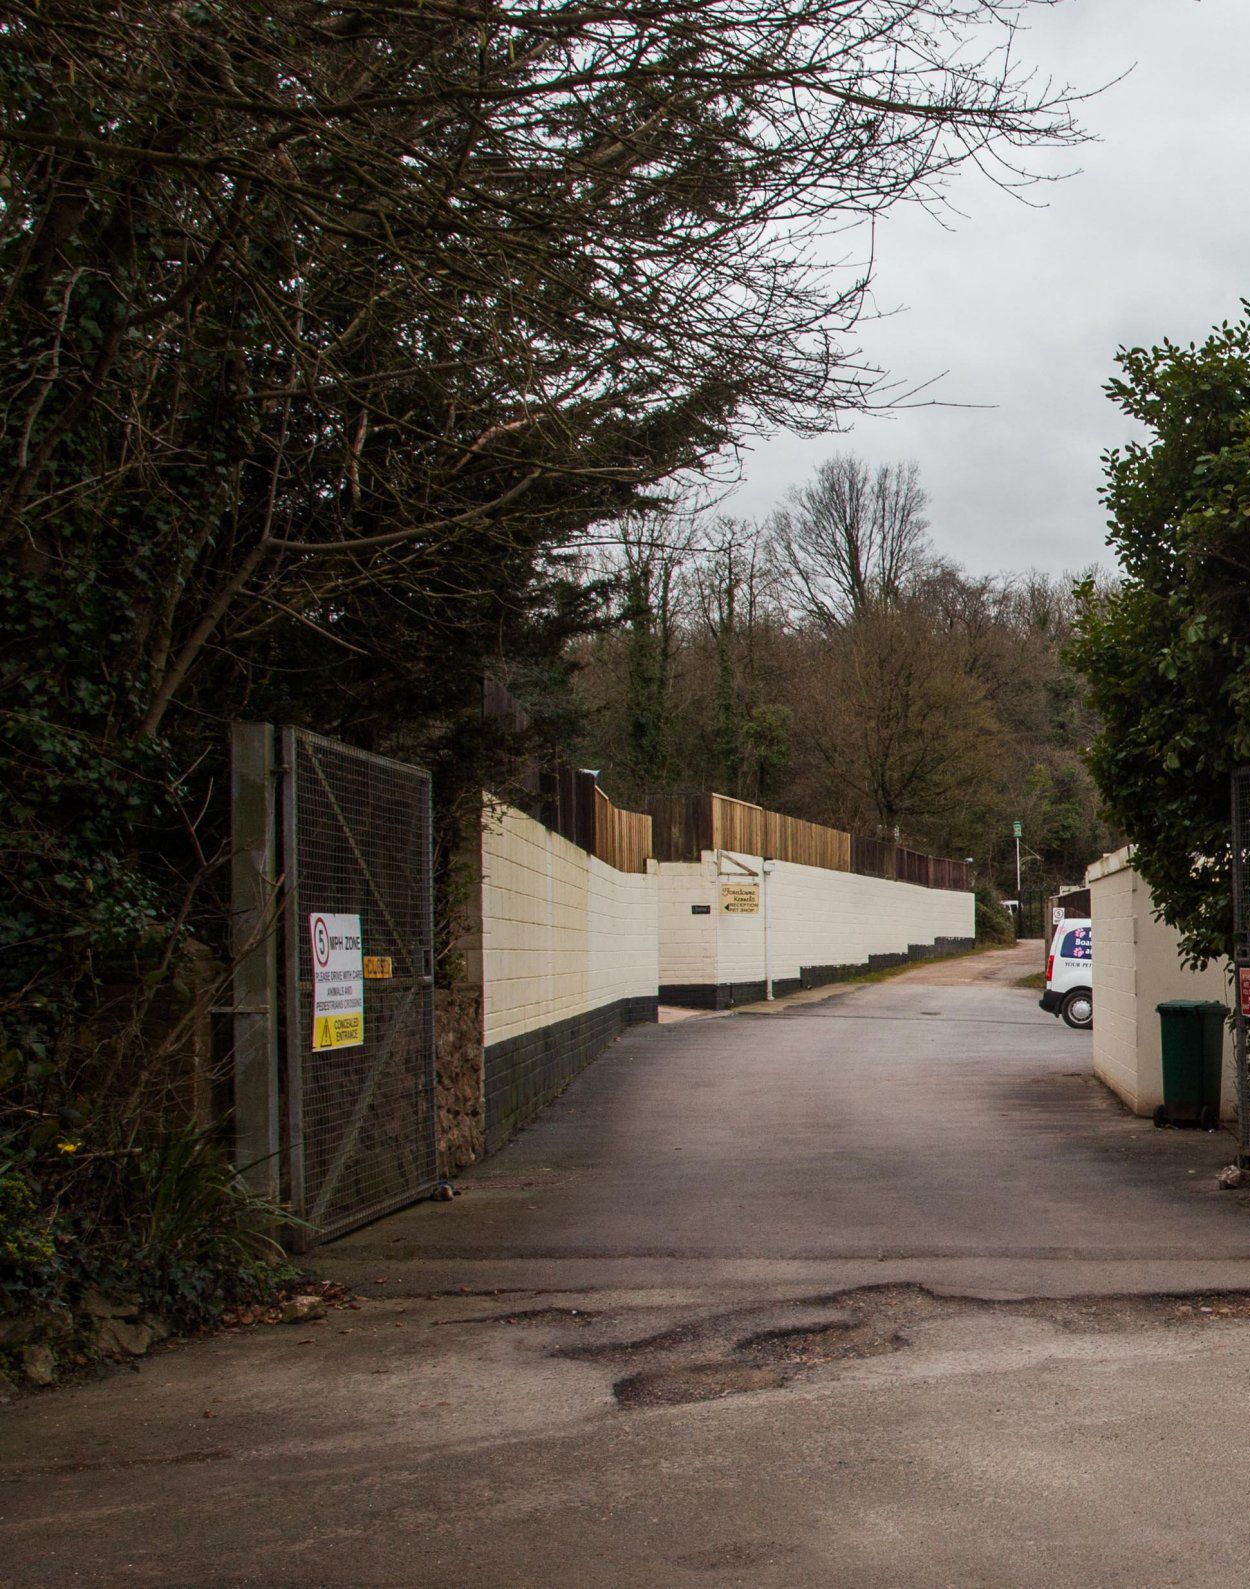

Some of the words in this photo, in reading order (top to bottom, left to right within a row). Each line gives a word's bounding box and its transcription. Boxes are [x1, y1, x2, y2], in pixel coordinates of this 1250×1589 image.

[722, 888, 756, 896] Foredowne
[319, 930, 325, 955] 5
[330, 936, 343, 951] MPH
[344, 936, 361, 951] ZONE
[315, 972, 330, 983] PLEASE
[330, 971, 343, 982] DRIVE
[343, 970, 352, 981] WITH
[352, 969, 363, 980] CARE
[344, 986, 353, 996] AND
[334, 1017, 359, 1029] CONCEALED
[336, 1028, 359, 1042] ENTRANCE
